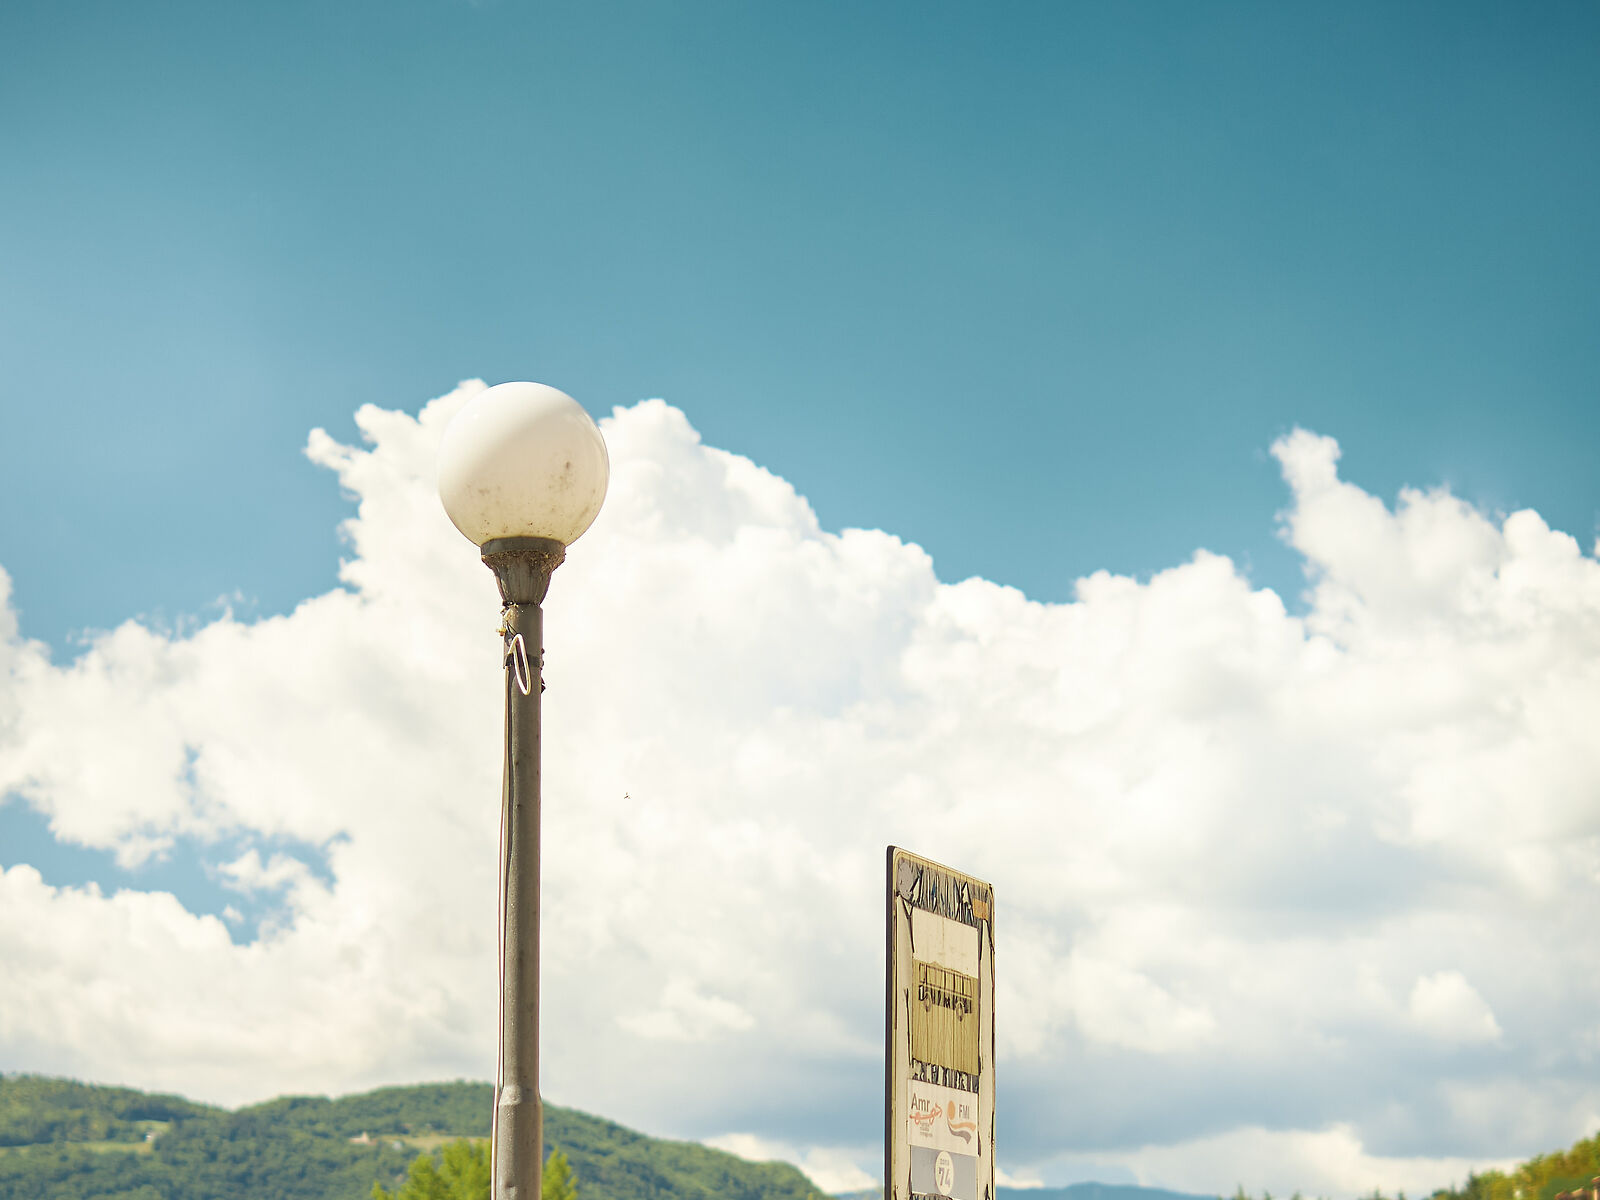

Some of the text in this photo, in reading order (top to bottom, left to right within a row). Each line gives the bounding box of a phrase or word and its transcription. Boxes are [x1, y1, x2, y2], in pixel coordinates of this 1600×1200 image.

[911, 1092, 930, 1113] Amr
[959, 1103, 970, 1120] FMI
[938, 1167, 951, 1188] 74
